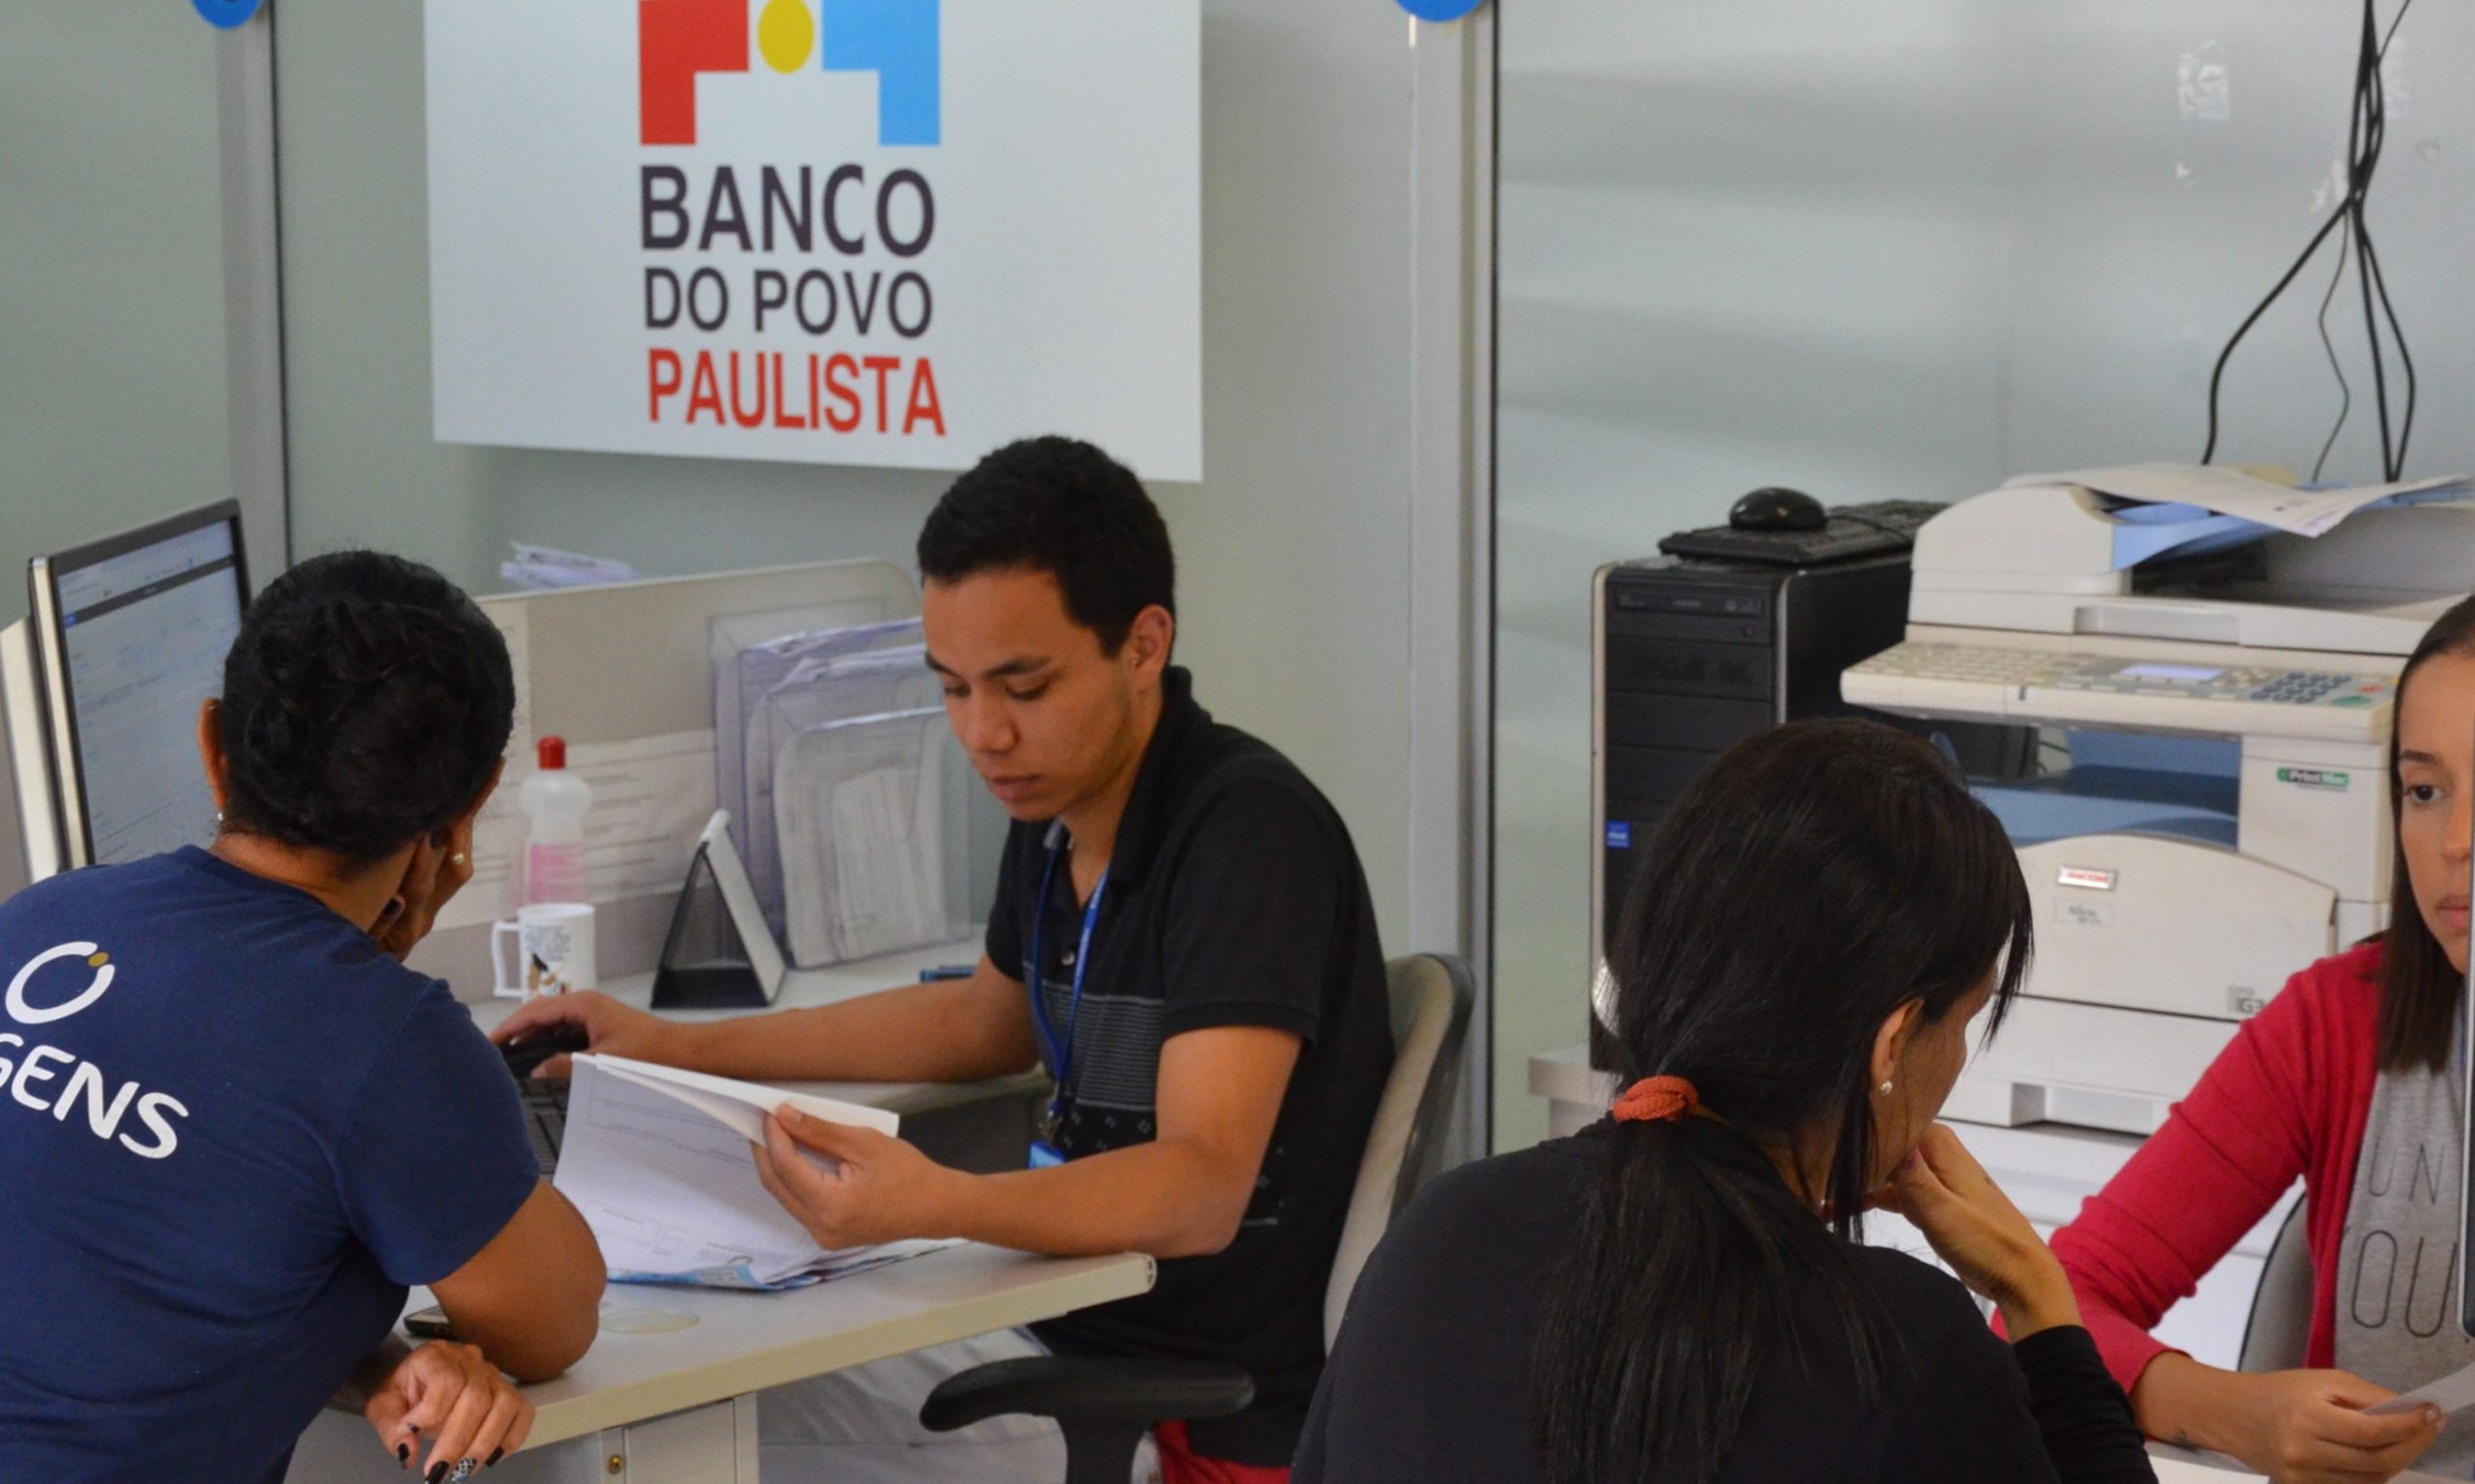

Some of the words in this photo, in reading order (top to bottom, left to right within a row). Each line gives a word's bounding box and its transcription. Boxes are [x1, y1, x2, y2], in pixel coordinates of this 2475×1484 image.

[640, 162, 936, 258] BANCO
[644, 266, 730, 333] DO
[753, 268, 933, 339] POVO
[649, 347, 946, 436] PAULISTA
[2344, 1228, 2458, 1339] OU
